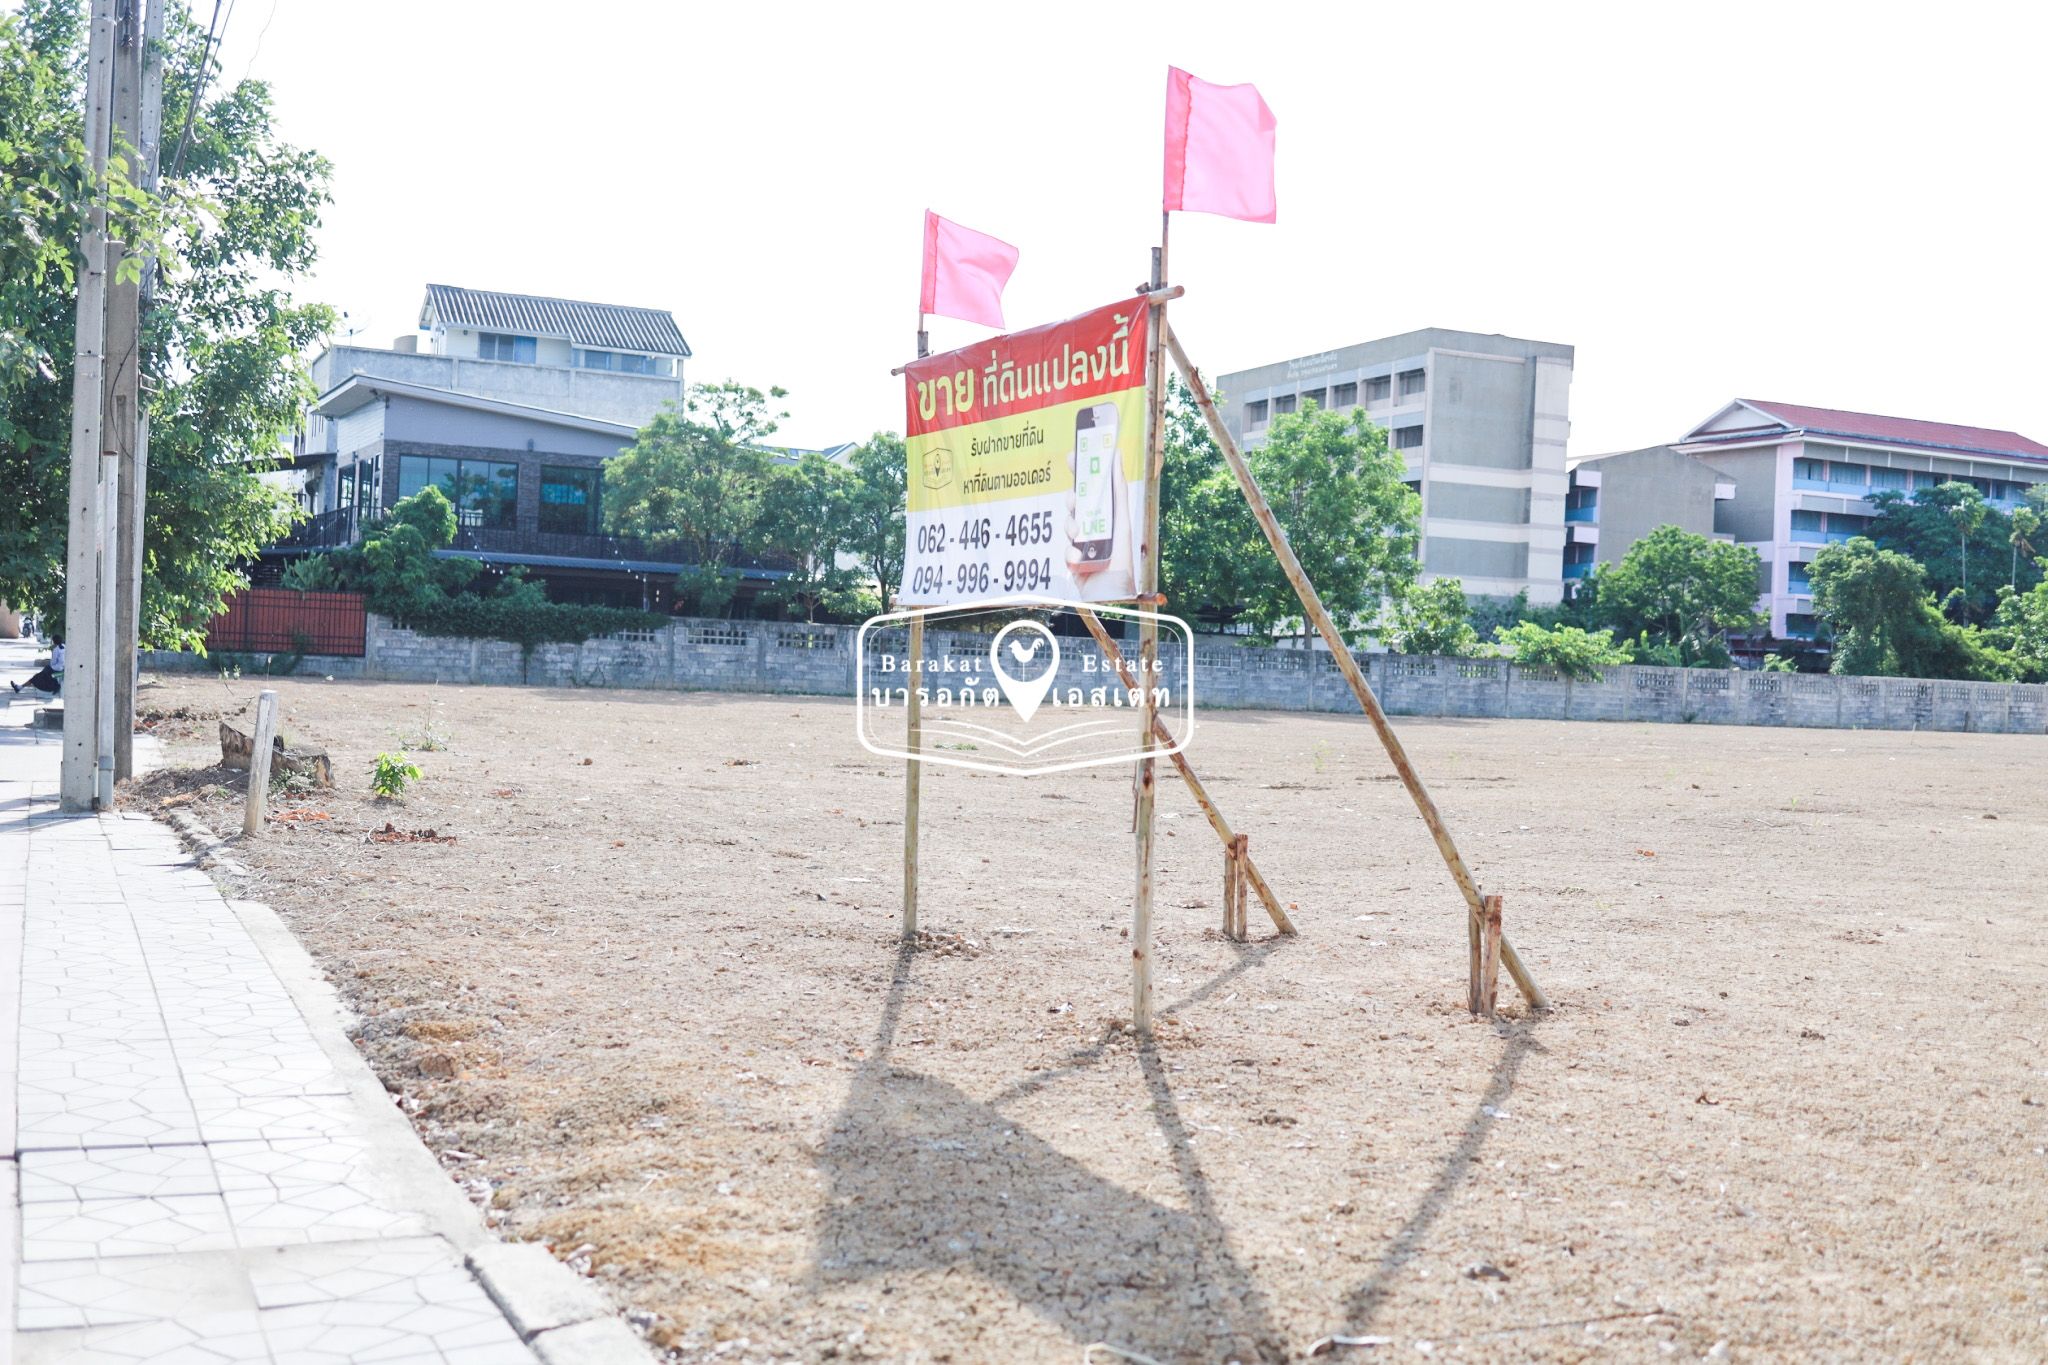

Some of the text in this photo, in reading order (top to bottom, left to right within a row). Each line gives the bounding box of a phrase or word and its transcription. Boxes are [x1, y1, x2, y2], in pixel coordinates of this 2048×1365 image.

[917, 313, 1130, 421] ขาย ที่ดินแปลงนี้
[971, 420, 1044, 456] รับฝากขายที่ดิน
[963, 460, 1052, 495] หาที่ดินตามออเดอร์
